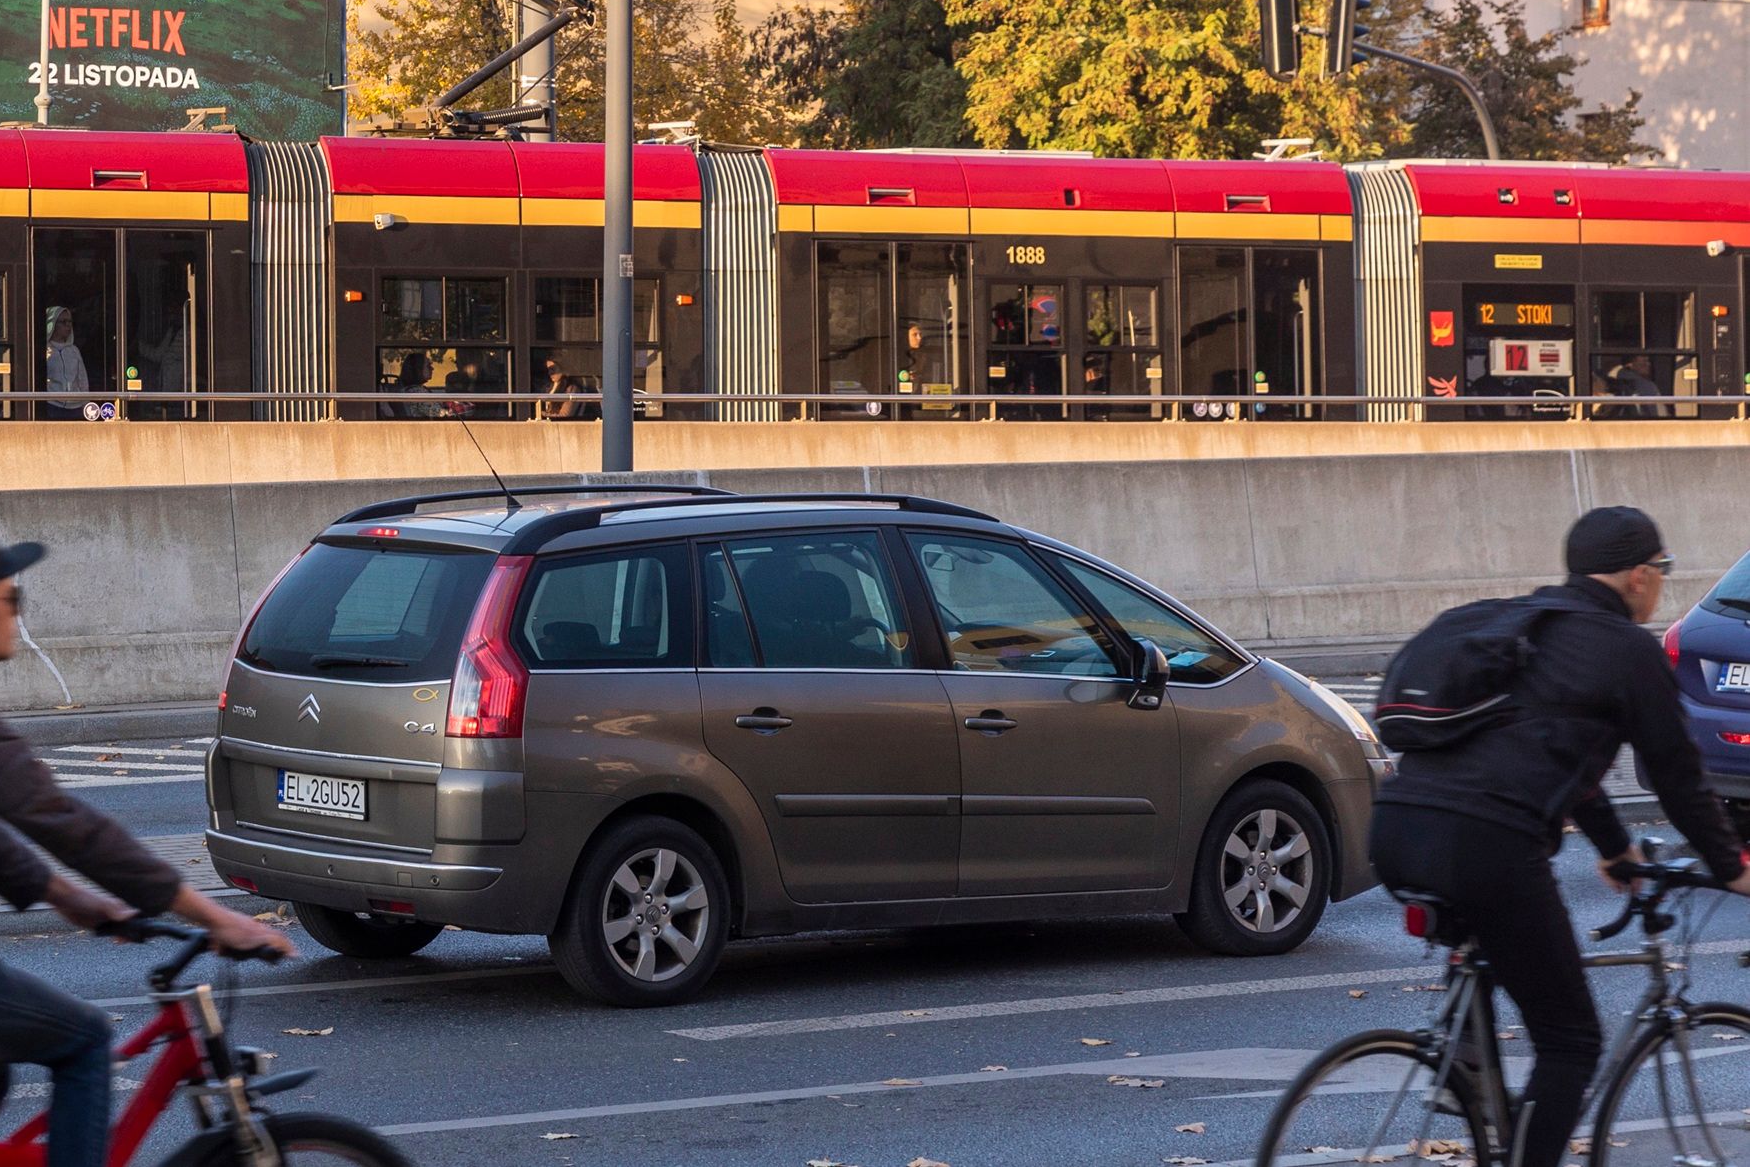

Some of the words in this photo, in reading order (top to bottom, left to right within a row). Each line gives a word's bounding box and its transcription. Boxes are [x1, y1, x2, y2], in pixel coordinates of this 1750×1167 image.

[49, 7, 186, 56] NETFLIX
[28, 62, 58, 84] 22
[64, 63, 200, 89] LISTOPADA
[1006, 246, 1046, 264] 1888
[1480, 304, 1495, 324] 12
[1516, 305, 1553, 325] STOKI
[1507, 345, 1528, 370] 12
[1729, 665, 1749, 686] EL
[404, 721, 437, 734] C4
[287, 775, 305, 802] EL
[311, 779, 361, 809] 2GU52
